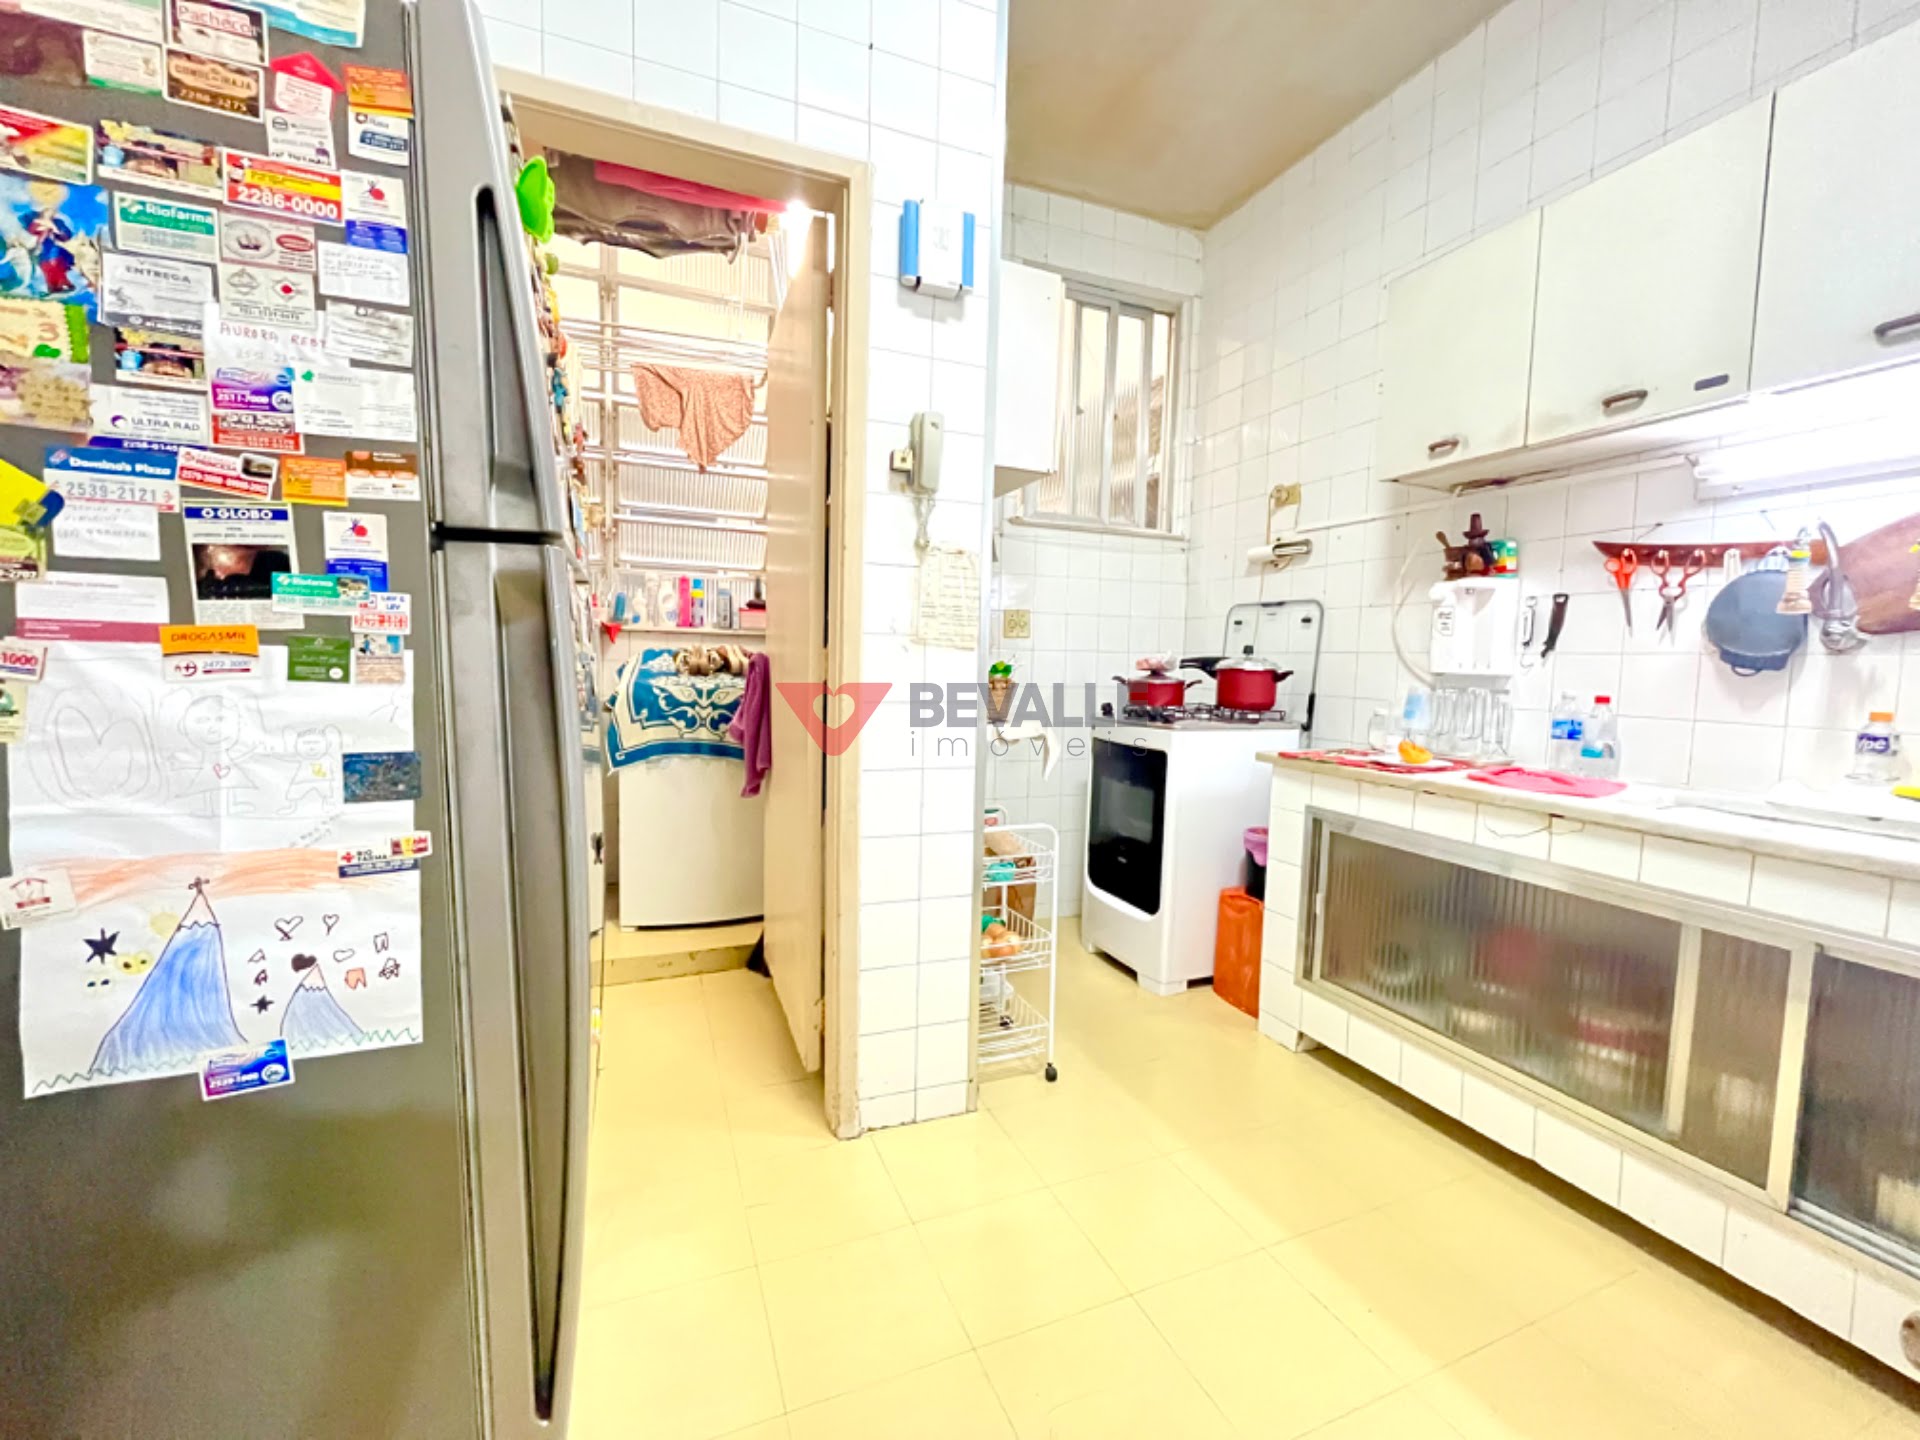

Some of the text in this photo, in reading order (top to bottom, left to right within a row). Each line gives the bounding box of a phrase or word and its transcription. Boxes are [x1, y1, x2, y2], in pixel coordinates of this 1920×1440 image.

[237, 185, 338, 219] 2286-0000
[146, 202, 213, 225] Riofarma
[125, 264, 191, 284] ENTREGA
[131, 416, 200, 432] ULTRA RAD
[69, 455, 172, 476] Domino's Pizza
[65, 481, 157, 501] 2539-2121
[201, 508, 272, 520] O GLOBO
